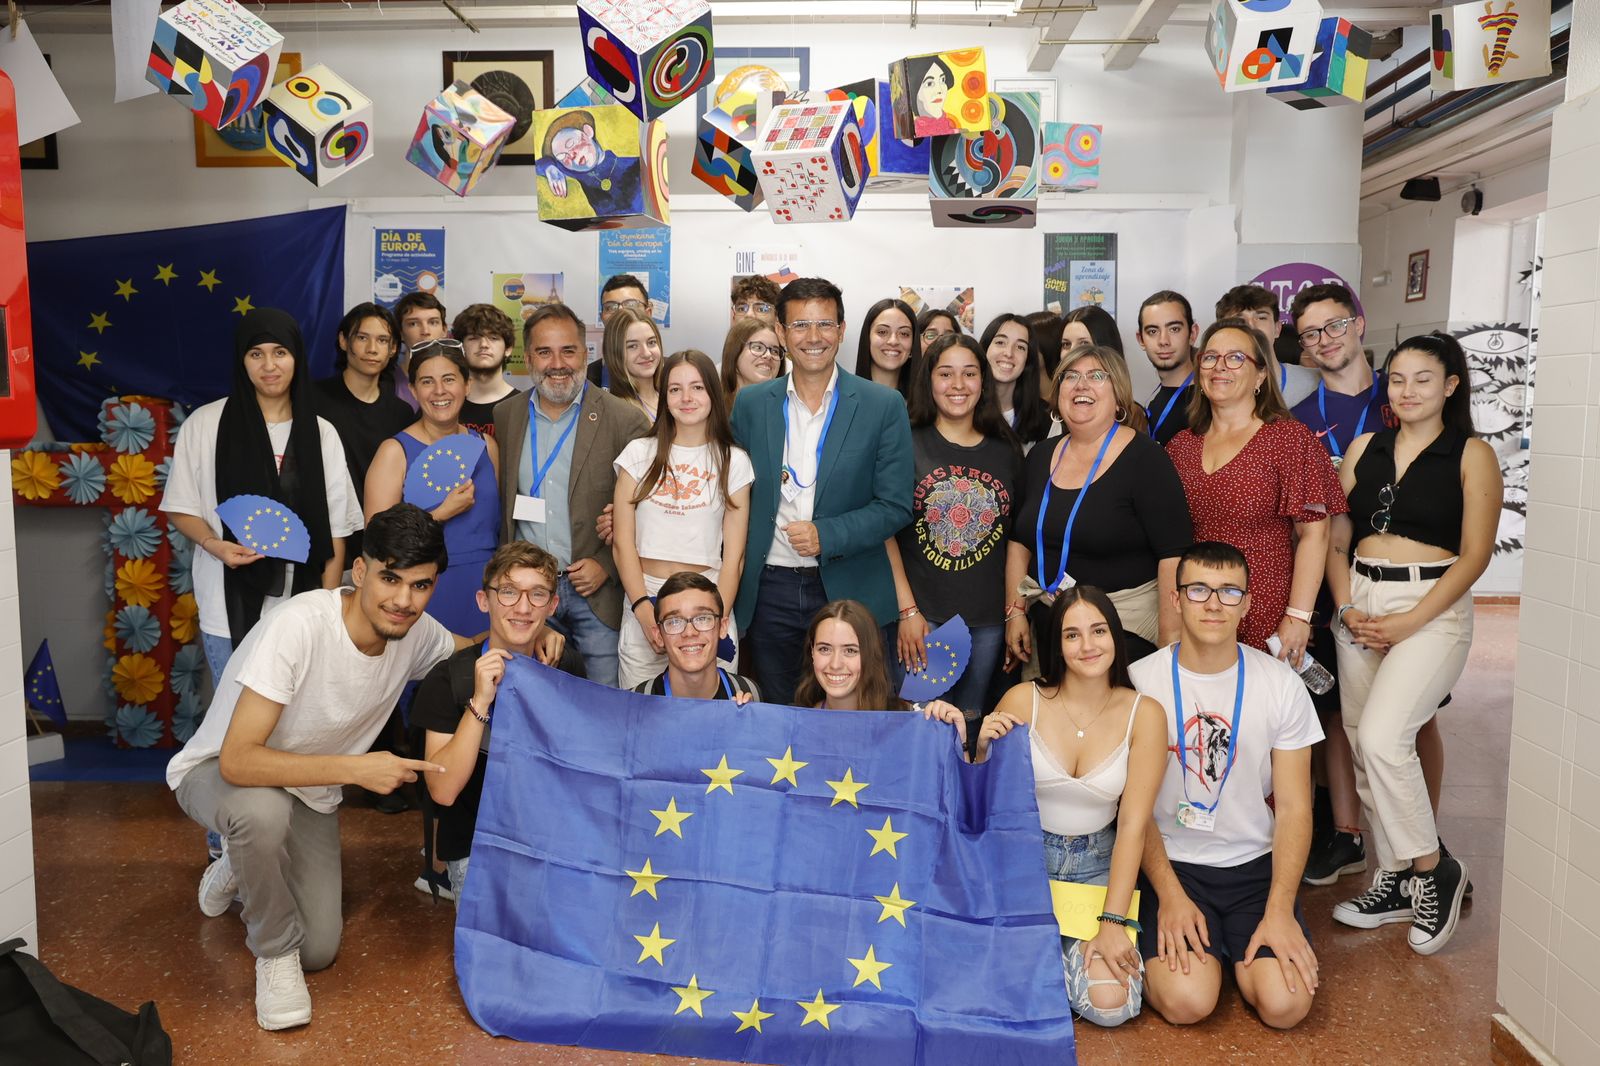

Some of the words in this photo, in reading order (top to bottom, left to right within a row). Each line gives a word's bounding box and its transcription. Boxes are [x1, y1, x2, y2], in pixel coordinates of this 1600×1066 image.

[381, 230, 401, 242] DÍA
[407, 233, 422, 242] DE
[381, 242, 426, 252] EUROPA
[736, 251, 755, 273] CINE
[1045, 283, 1067, 292] OVER
[969, 467, 1010, 516] ROSES
[915, 518, 927, 544] USE
[923, 544, 952, 571] YOUR
[954, 523, 1004, 571] ILLUSION
